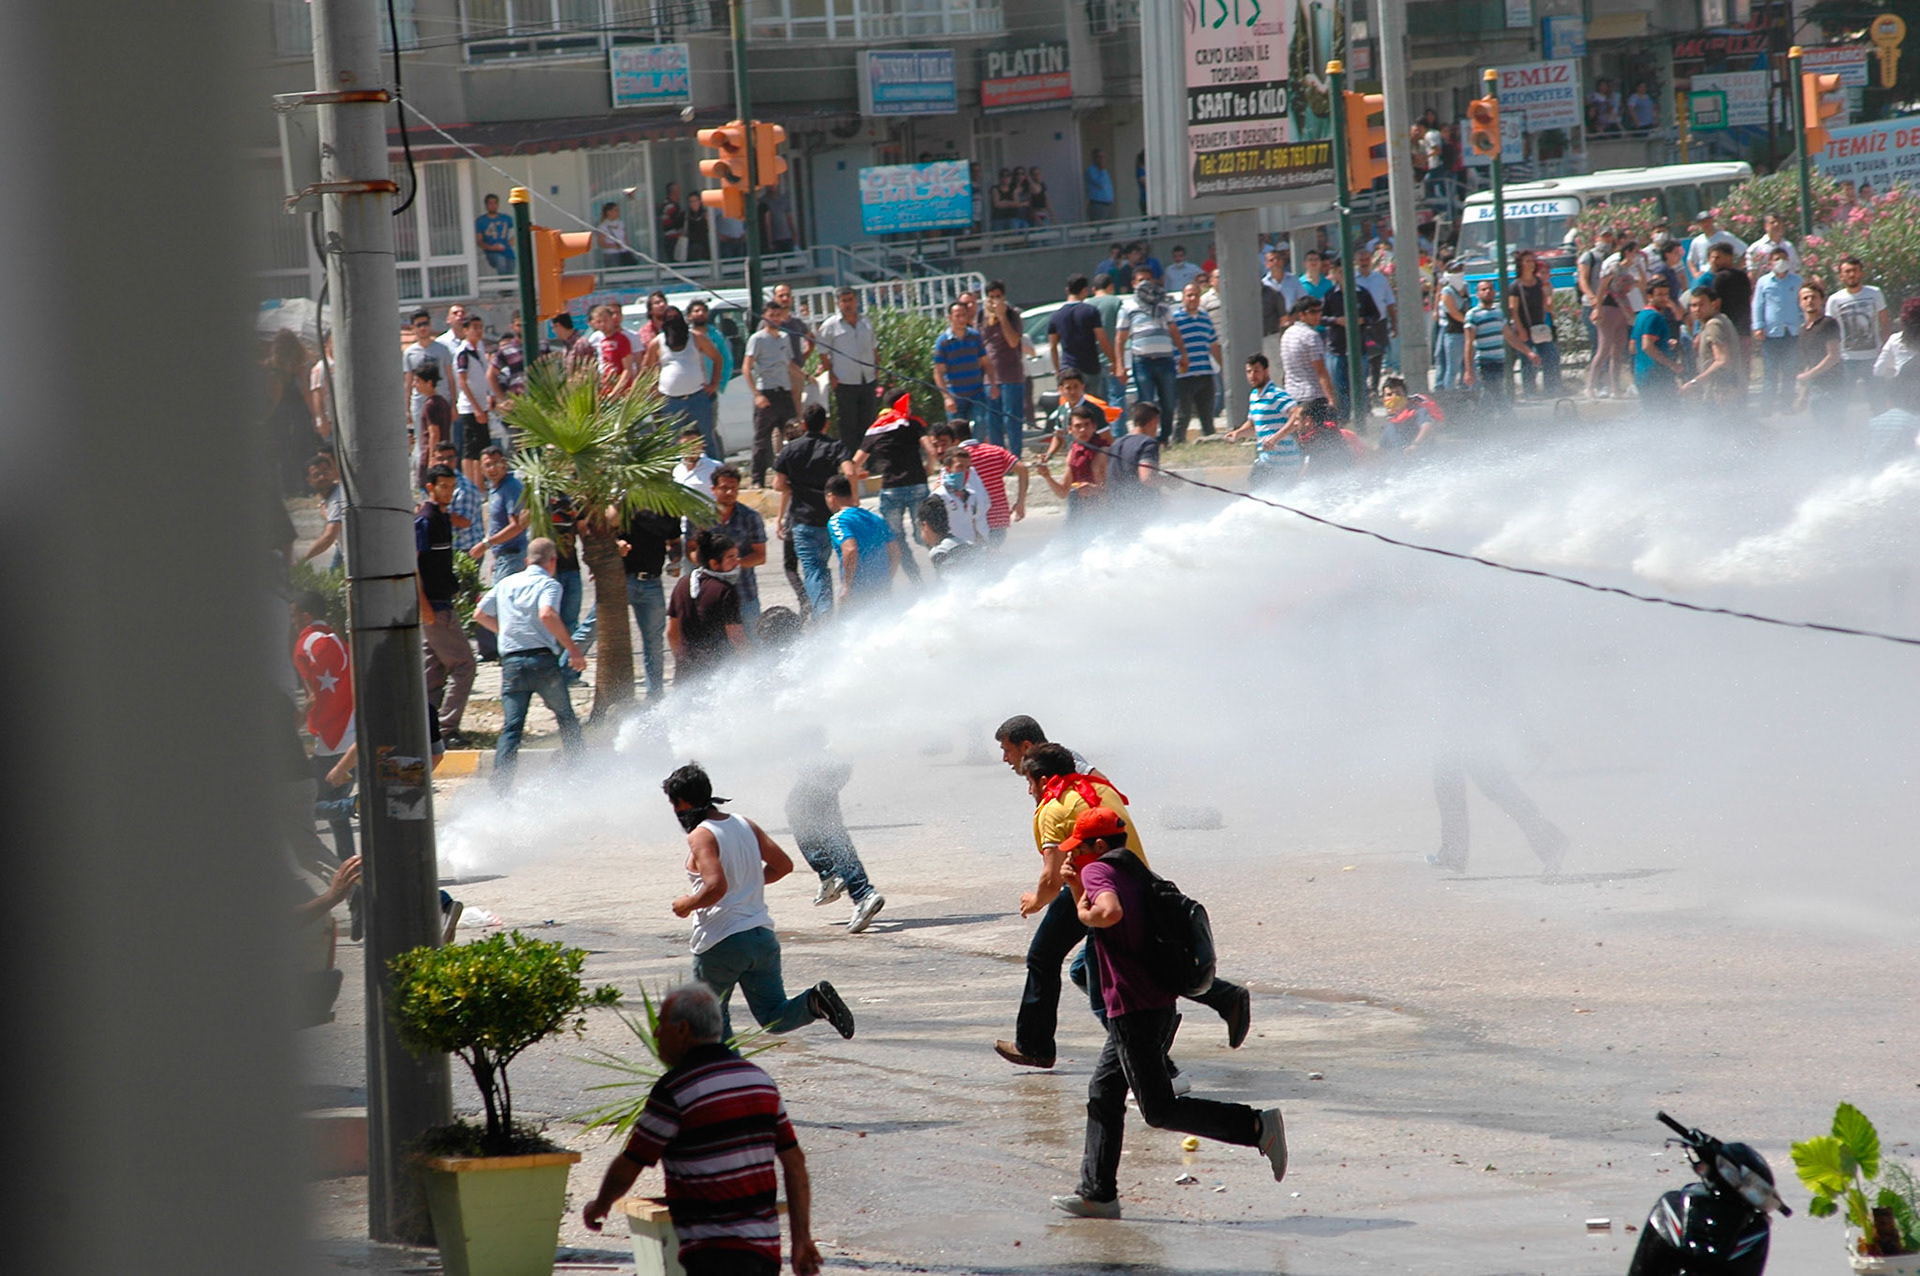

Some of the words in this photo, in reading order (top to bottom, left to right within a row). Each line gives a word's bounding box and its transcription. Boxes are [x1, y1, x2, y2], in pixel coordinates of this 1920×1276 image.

[988, 42, 1064, 78] PLATİN
[616, 73, 687, 95] EMLAK
[1502, 62, 1570, 89] EMİZ
[1197, 91, 1233, 120] SAAT
[1234, 93, 1247, 117] te
[1249, 91, 1257, 115] 6
[1258, 82, 1287, 114] KİLO
[1826, 128, 1889, 159] TEMİZ
[864, 182, 970, 205] EMLAK
[1479, 202, 1560, 219] BATACIK
